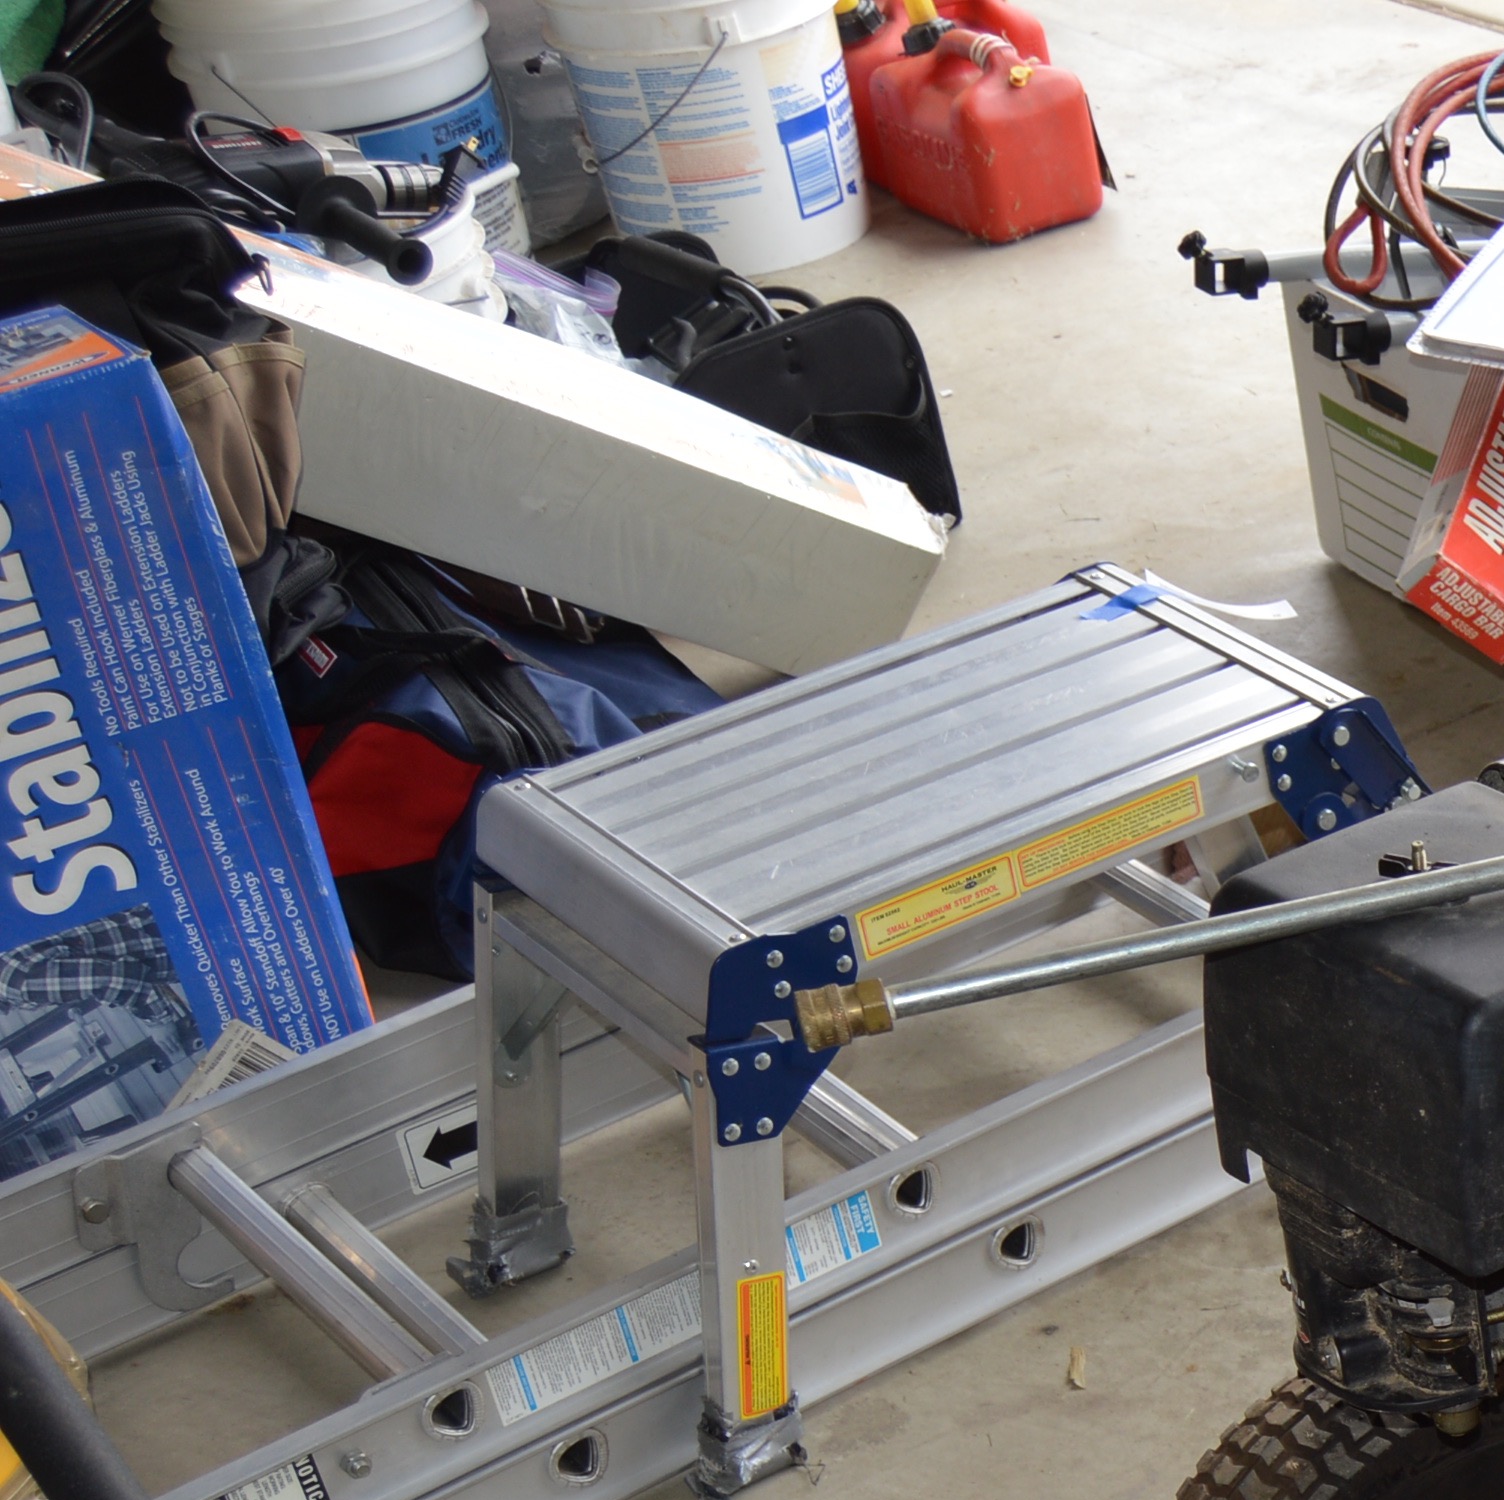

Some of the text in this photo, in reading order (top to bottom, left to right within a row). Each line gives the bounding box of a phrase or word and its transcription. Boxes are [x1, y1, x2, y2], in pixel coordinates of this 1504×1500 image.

[63, 448, 162, 723] For Use on Werner Fiberglass & Aluminum
[107, 468, 198, 711] Not to be Used on Extension Ladders
[119, 449, 213, 707] in Conjunction with Ladder Jacks Using
[1429, 580, 1504, 640] CARGO BAR
[75, 568, 142, 729] Paint Can Hook Included
[126, 597, 178, 718] Extension Ladders
[181, 595, 228, 702] Planks or Stages
[67, 616, 121, 735] No Tools Required
[125, 778, 164, 847] Stabilizers
[183, 767, 216, 818] Around
[202, 818, 230, 855] Work
[216, 854, 236, 870] to
[152, 848, 180, 886] Other
[223, 871, 246, 898] You
[940, 864, 997, 893] HAUL-MASTER
[167, 887, 194, 922] Than
[233, 898, 260, 933] Allow
[885, 919, 911, 935] SMALL
[912, 902, 952, 924] ALUMINUM
[953, 893, 973, 907] STEP
[974, 883, 998, 899] STOOL
[181, 923, 213, 970] Quicker
[240, 870, 305, 1012] Gutters and Overhangs
[247, 935, 282, 990] Standoff
[267, 865, 344, 1038] NOT Use on Ladders Over 40'
[225, 957, 255, 1002] Surface
[277, 1012, 295, 1022] &
[849, 1203, 865, 1235] FIRST
[857, 1194, 875, 1235] SAFETY
